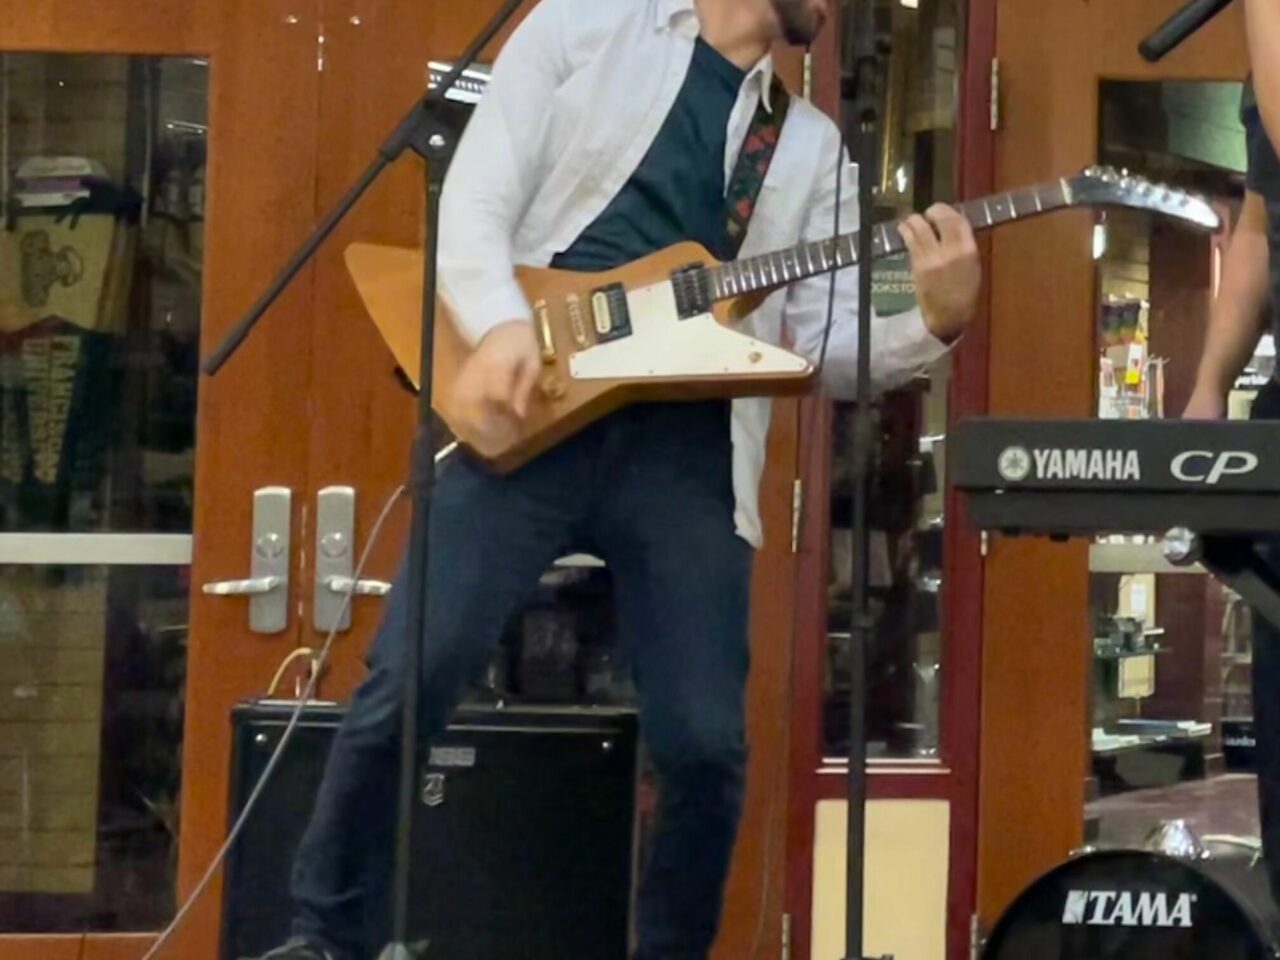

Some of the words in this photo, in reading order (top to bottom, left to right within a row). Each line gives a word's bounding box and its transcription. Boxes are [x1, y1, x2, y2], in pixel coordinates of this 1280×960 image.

[1033, 449, 1140, 480] YAMAHA
[1170, 450, 1258, 484] CP
[1086, 890, 1193, 927] TAMA
